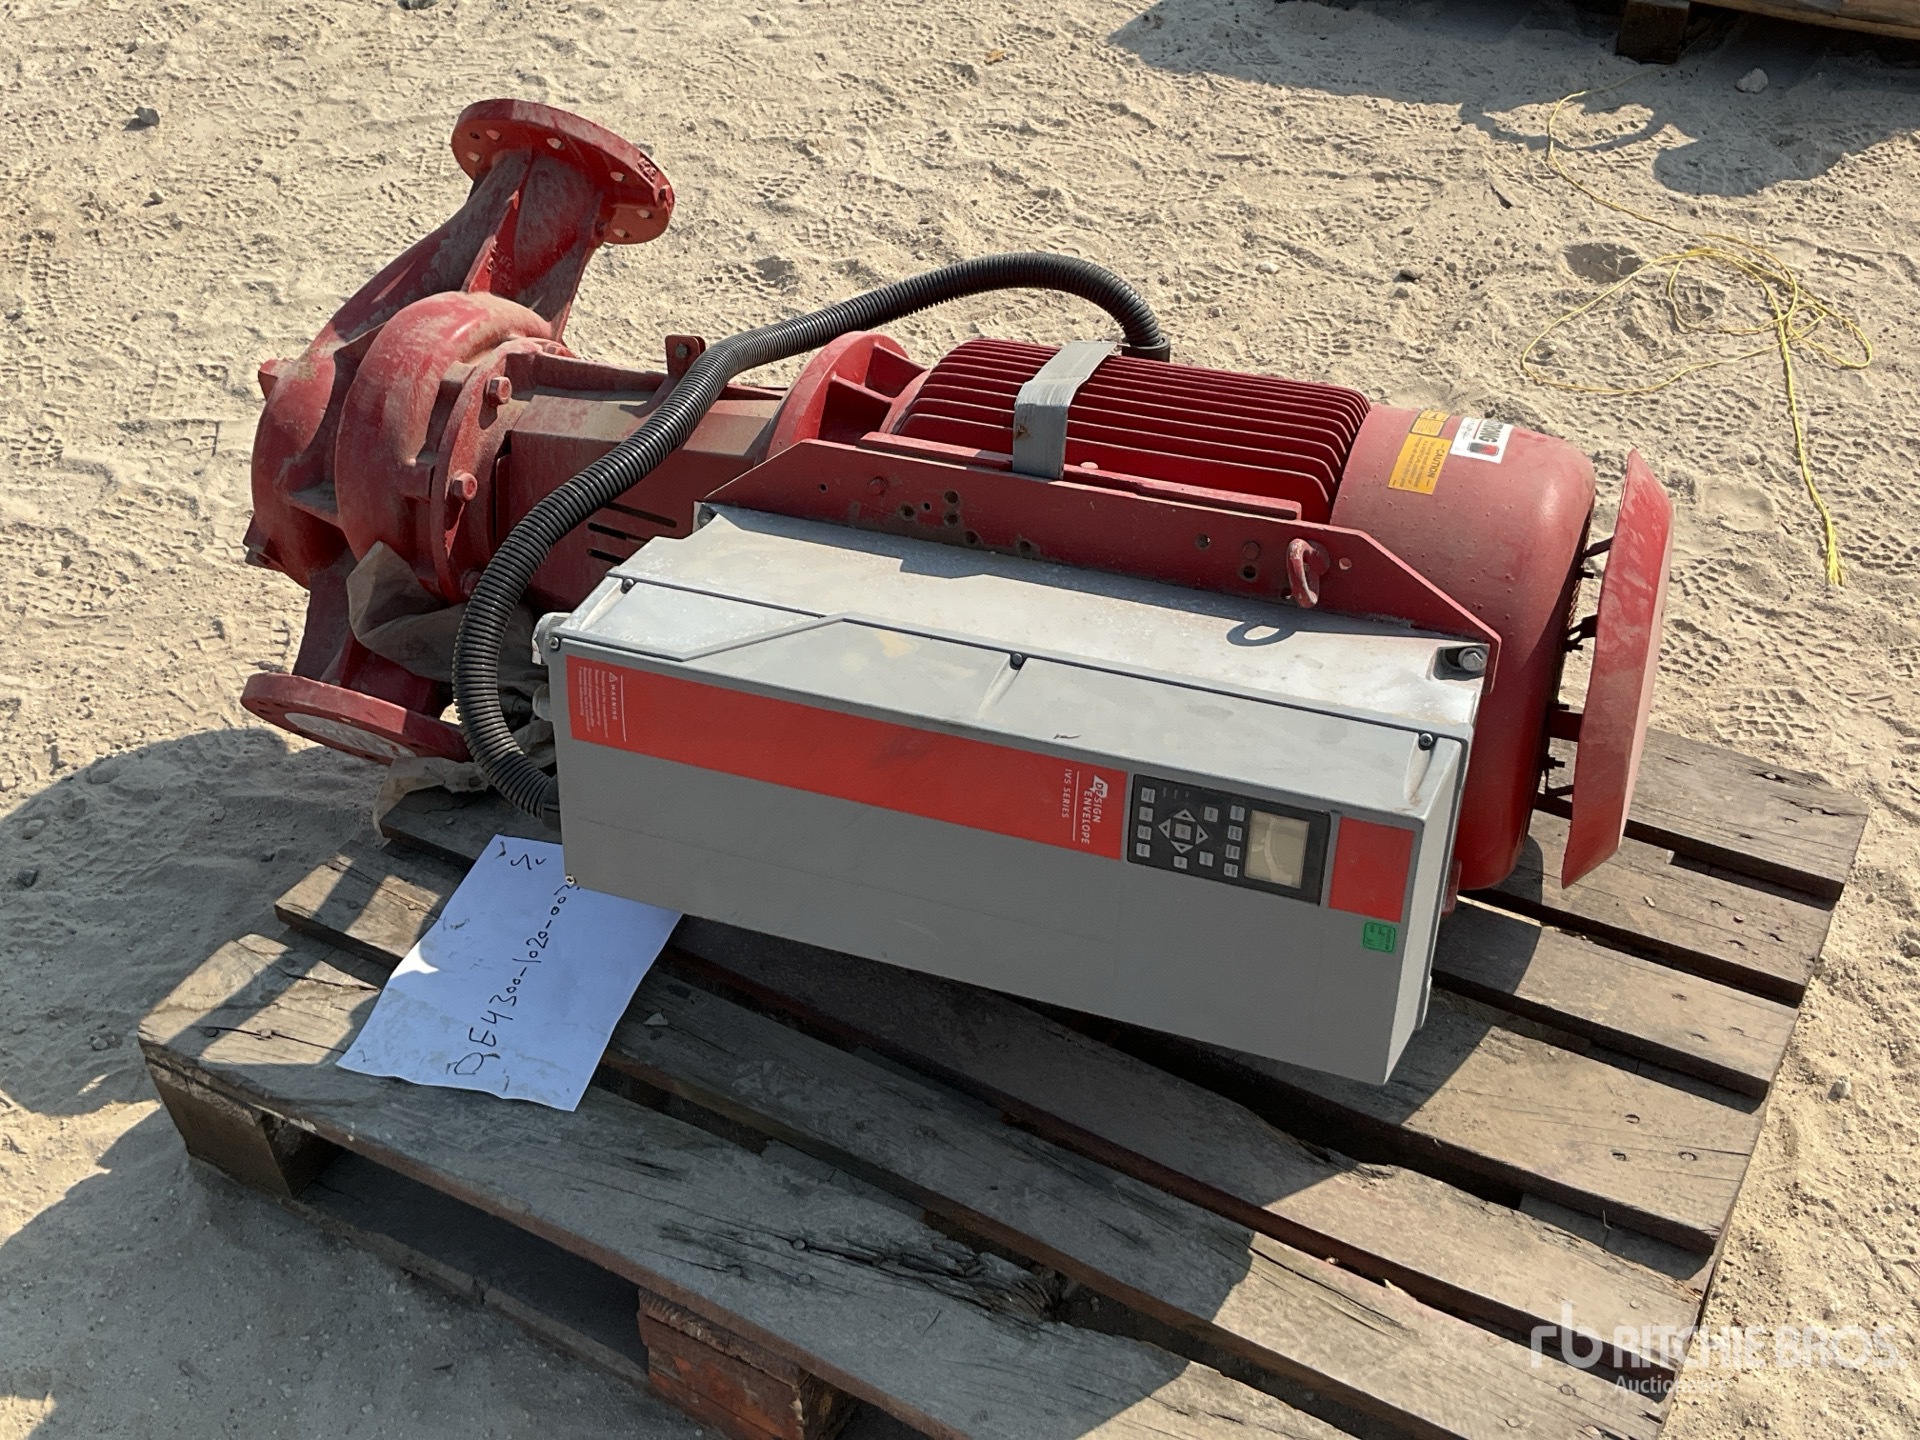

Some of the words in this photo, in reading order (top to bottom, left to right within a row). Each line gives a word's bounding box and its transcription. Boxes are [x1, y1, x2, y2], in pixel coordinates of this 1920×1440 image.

[1427, 449, 1445, 478] CAUTION
[1064, 768, 1073, 784] IVS
[1062, 788, 1071, 818] SERIES
[1081, 790, 1092, 844] ENVELOPE
[1092, 782, 1104, 823] DESIGN
